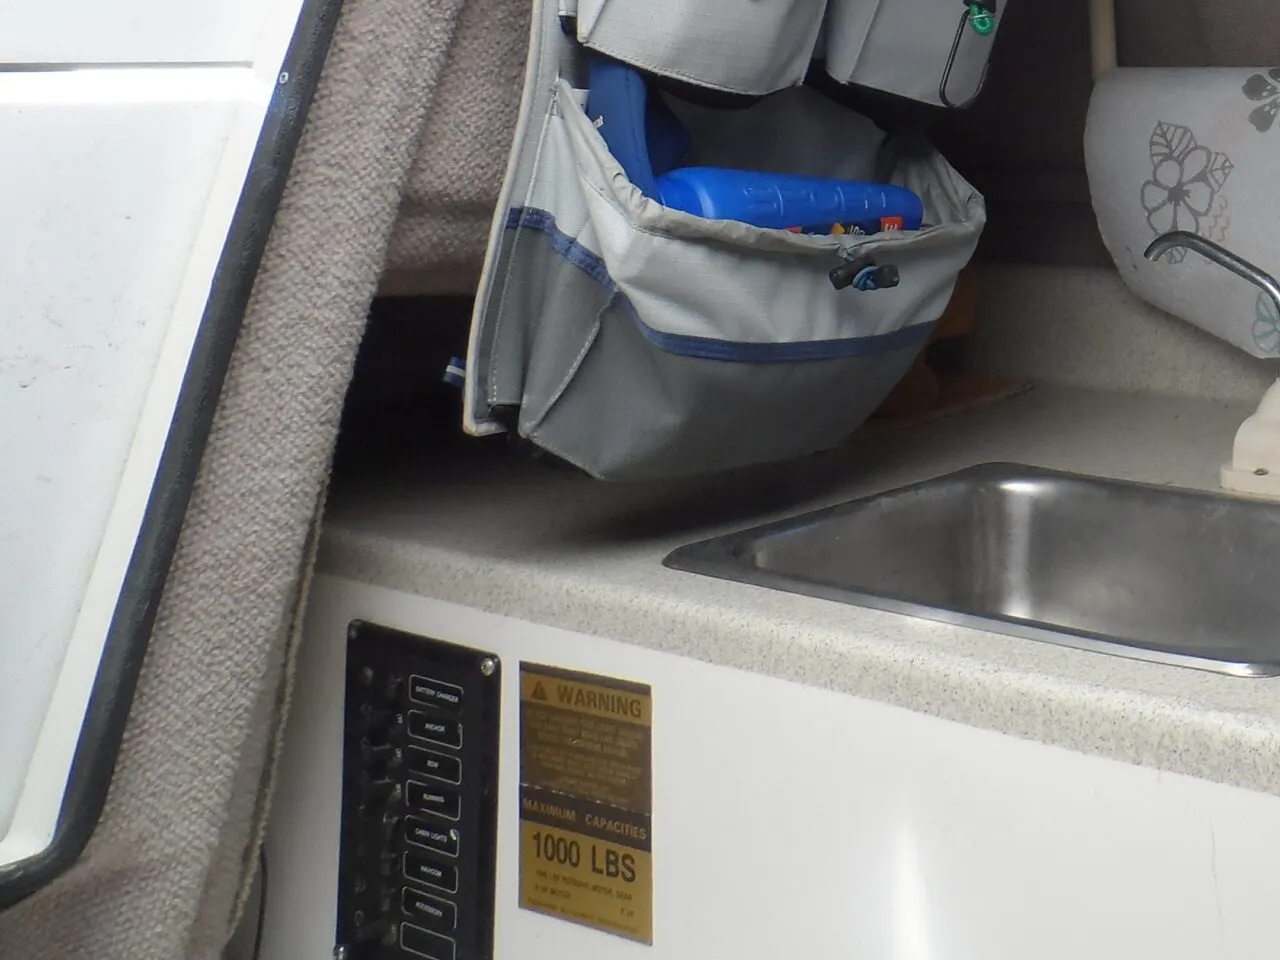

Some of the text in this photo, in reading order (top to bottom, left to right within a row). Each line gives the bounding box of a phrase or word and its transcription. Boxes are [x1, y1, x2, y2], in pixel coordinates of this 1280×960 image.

[557, 684, 642, 718] WARNING
[522, 797, 647, 840] MAXIMUM CAPACITIES
[532, 831, 580, 868] 1000
[591, 844, 637, 883] LBS
